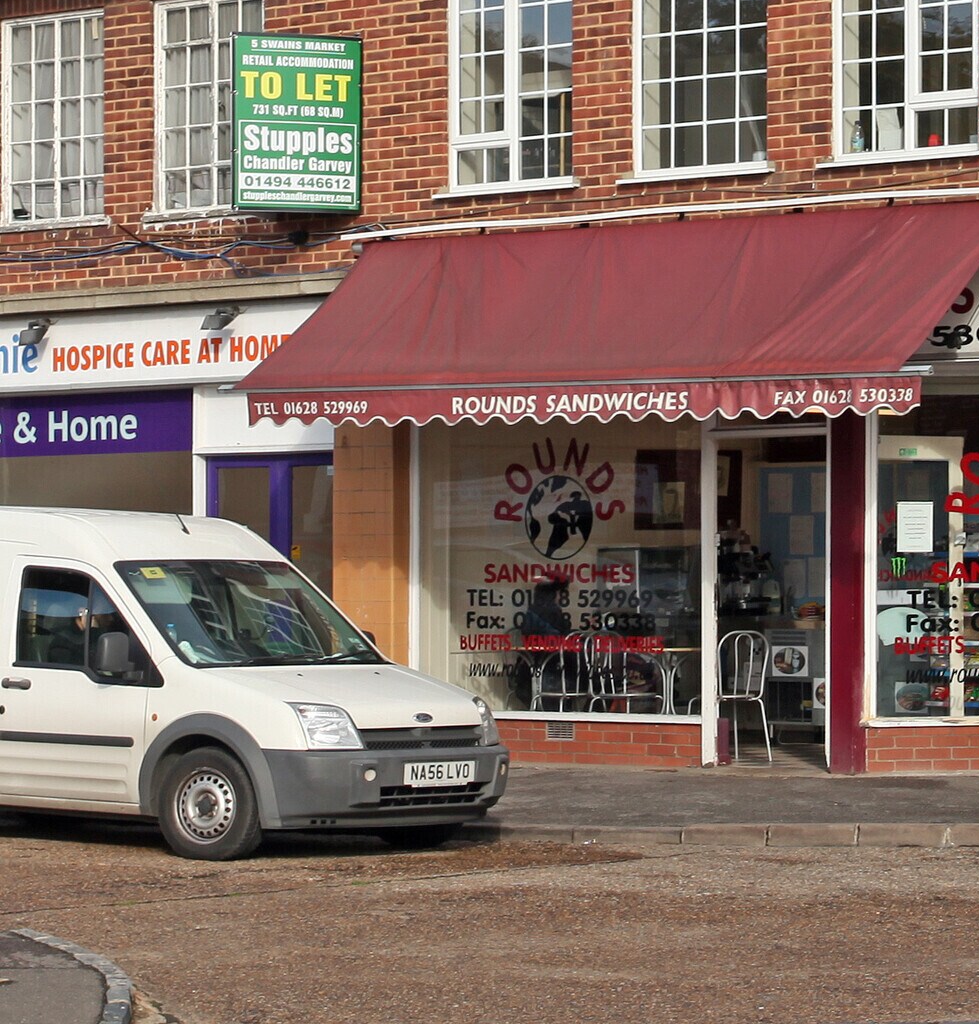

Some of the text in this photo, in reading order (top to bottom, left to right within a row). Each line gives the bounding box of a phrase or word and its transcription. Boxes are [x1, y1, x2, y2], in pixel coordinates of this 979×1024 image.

[251, 40, 346, 52] 5 SWAINS MARKET
[242, 55, 354, 70] RETAIL ACCOMMODATION
[240, 71, 352, 102] TO LET
[253, 104, 344, 118] 731 SQ.FT (68 SQ.M)
[243, 124, 353, 155] Stupples
[243, 155, 352, 174] Chandler Garvey
[244, 176, 351, 189] 01494 446612
[243, 191, 352, 203] stuppleschandlergarvey.com
[52, 342, 134, 372] HOSPICE
[141, 338, 191, 367] CARE
[197, 337, 223, 363] AT
[451, 390, 689, 415] ROUNDS SANDWICHES
[773, 388, 914, 406] FAX 01628 530338
[254, 400, 368, 415] TEL 01628 529969
[13, 411, 37, 444] &
[48, 410, 138, 443] Home
[494, 437, 626, 523] ROUNDS
[484, 563, 636, 584] SANDWICHES
[466, 589, 504, 607] TEL:
[577, 589, 653, 608] 529969
[907, 589, 958, 609] TEL:
[466, 611, 506, 630] Fax:
[906, 613, 960, 633] Fax:
[459, 635, 665, 655] BUFFETS VENDING DELIVERIES
[894, 635, 965, 655] BUFFETS
[410, 763, 470, 781] NA56 LVO
